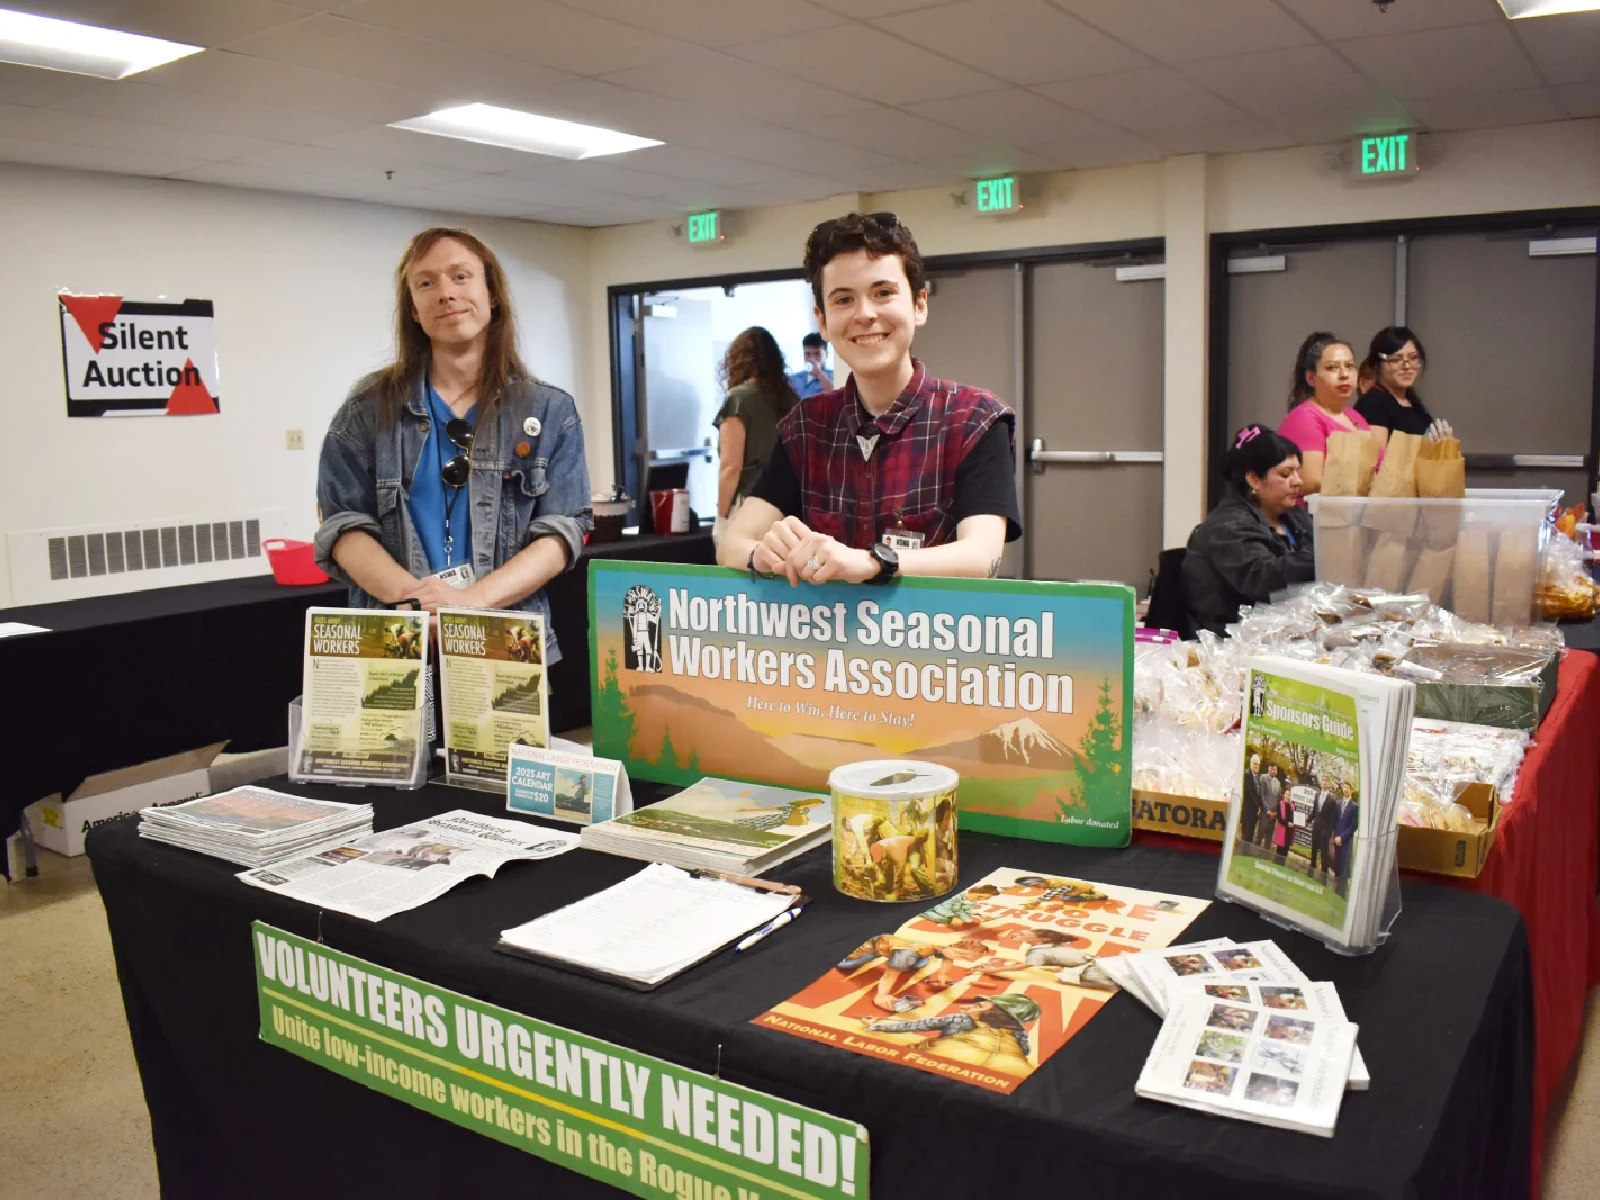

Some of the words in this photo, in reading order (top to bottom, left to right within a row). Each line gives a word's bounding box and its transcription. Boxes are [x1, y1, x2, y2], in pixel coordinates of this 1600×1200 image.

[1362, 135, 1408, 174] EXIT
[977, 177, 1014, 211] EXIT
[688, 212, 717, 242] EXIT
[98, 322, 188, 350] Silent
[82, 360, 200, 387] Auction
[313, 624, 362, 640] SEASONAL
[444, 622, 487, 641] SEASONAL
[668, 587, 848, 643] Northwest
[856, 600, 1054, 659] Seasonal
[313, 639, 360, 654] WORKERS
[445, 639, 486, 656] WORKERS
[668, 634, 816, 689] Workers
[824, 648, 1074, 714] Association
[746, 696, 775, 711] Here
[779, 701, 791, 713] to
[796, 702, 825, 718] Win,
[829, 705, 859, 721] Here
[863, 711, 876, 723] to
[880, 710, 916, 729] Stay!
[1266, 700, 1321, 731] Sponsors
[1322, 714, 1354, 741] Guide
[515, 766, 535, 778] 2025
[536, 771, 551, 782] ART
[547, 755, 570, 764] LABOR
[572, 757, 617, 772] FEDERATION
[511, 776, 554, 792] CALENDAR
[534, 792, 549, 802] $20
[81, 810, 139, 833] Americ
[1061, 815, 1085, 825] Labor
[1086, 818, 1119, 829] donated
[1131, 799, 1226, 832] ATORA
[256, 931, 448, 1048] VOLUNTEERS
[454, 1004, 650, 1119] URGENTLY
[661, 1073, 857, 1197] NEEDED!
[764, 1015, 837, 1041] NATIONAL
[843, 1036, 900, 1057] LABOR
[902, 1053, 1010, 1088] FEDERATION
[272, 1005, 321, 1050] Unite
[323, 1027, 447, 1104] low-income
[450, 1083, 551, 1144] workers
[556, 1119, 583, 1158] in
[588, 1130, 633, 1176] the
